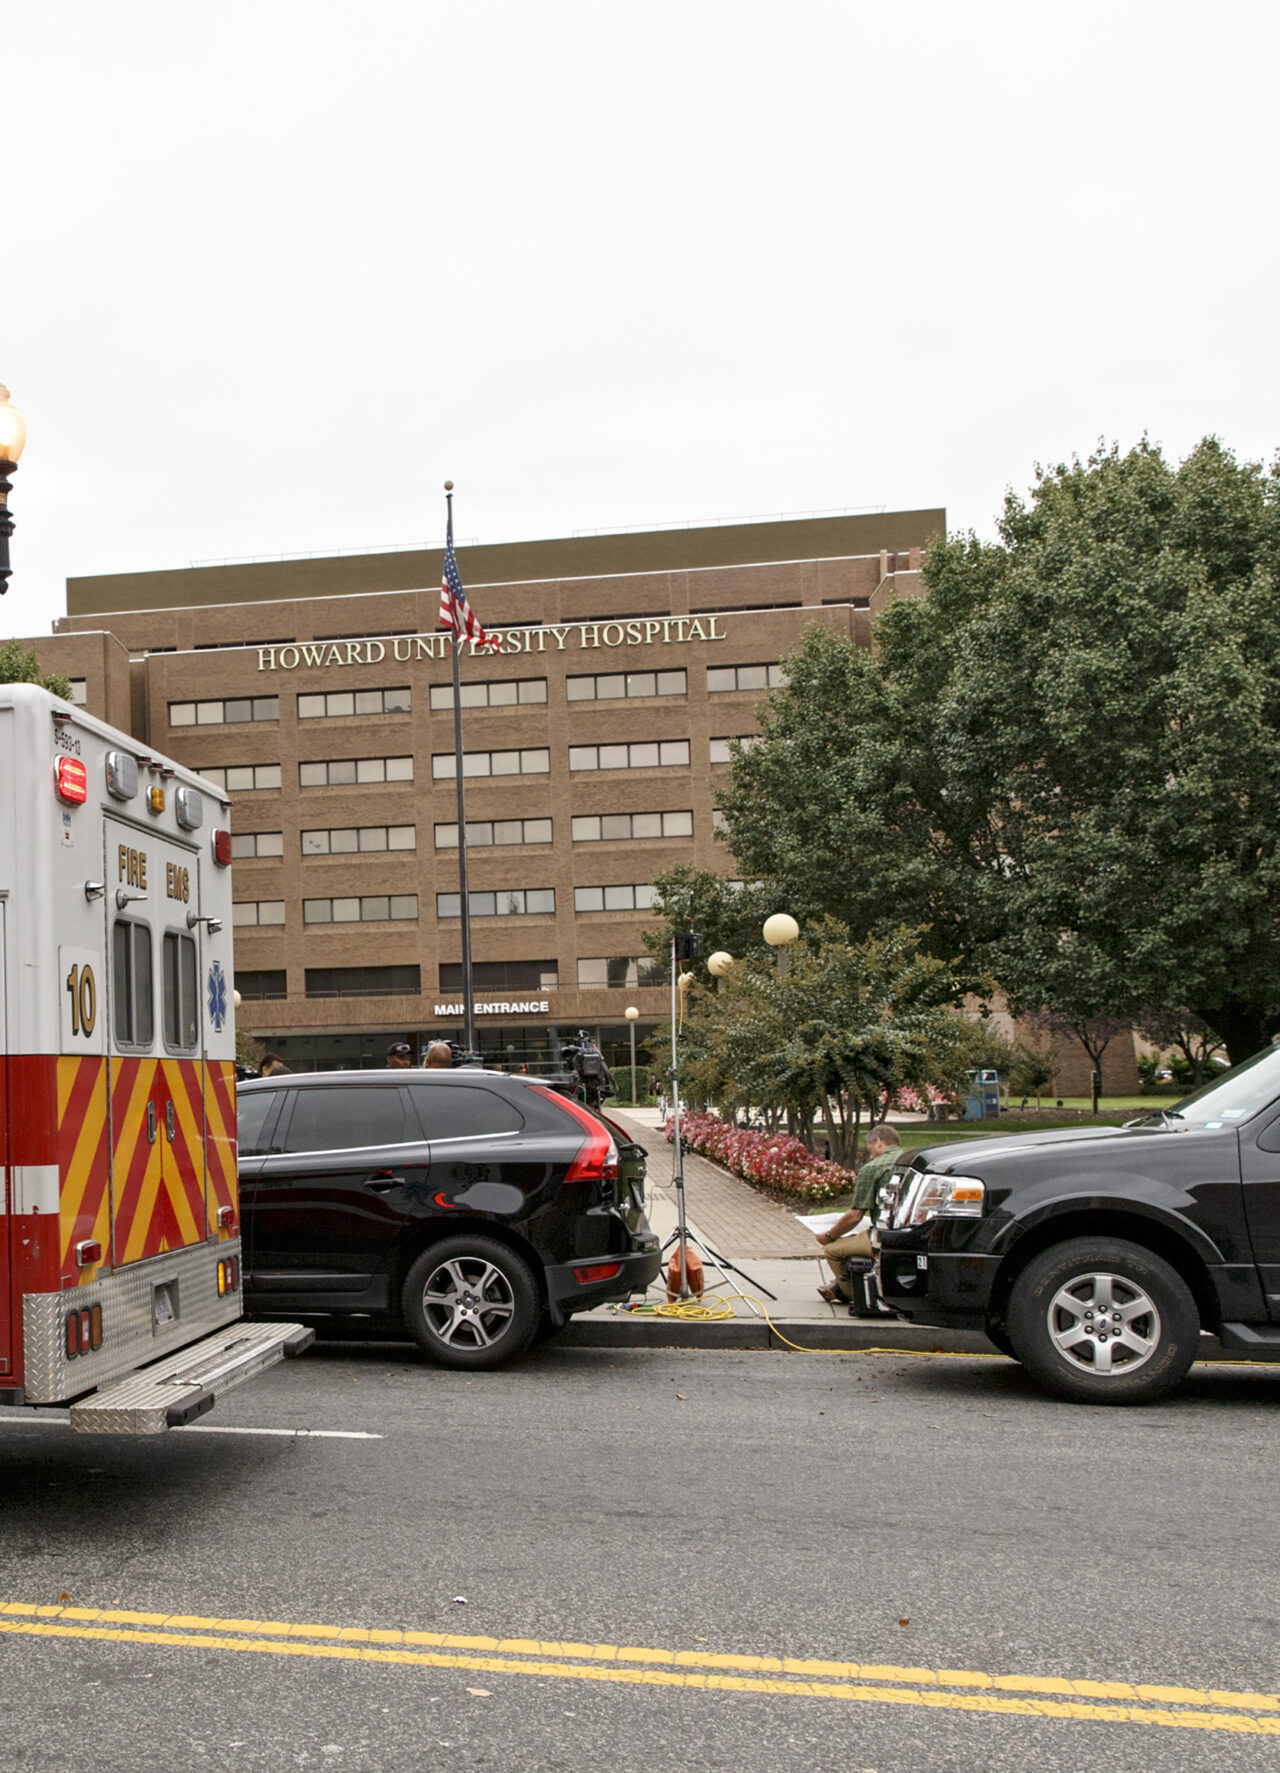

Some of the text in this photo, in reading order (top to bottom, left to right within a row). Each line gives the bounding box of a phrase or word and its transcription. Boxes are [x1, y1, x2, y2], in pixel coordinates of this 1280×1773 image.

[256, 641, 386, 671] HOWARD
[578, 616, 728, 649] HOSPITAL
[118, 844, 191, 904] FIRE EMS
[67, 963, 97, 1039] 10
[473, 1001, 549, 1015] ENTRANCE
